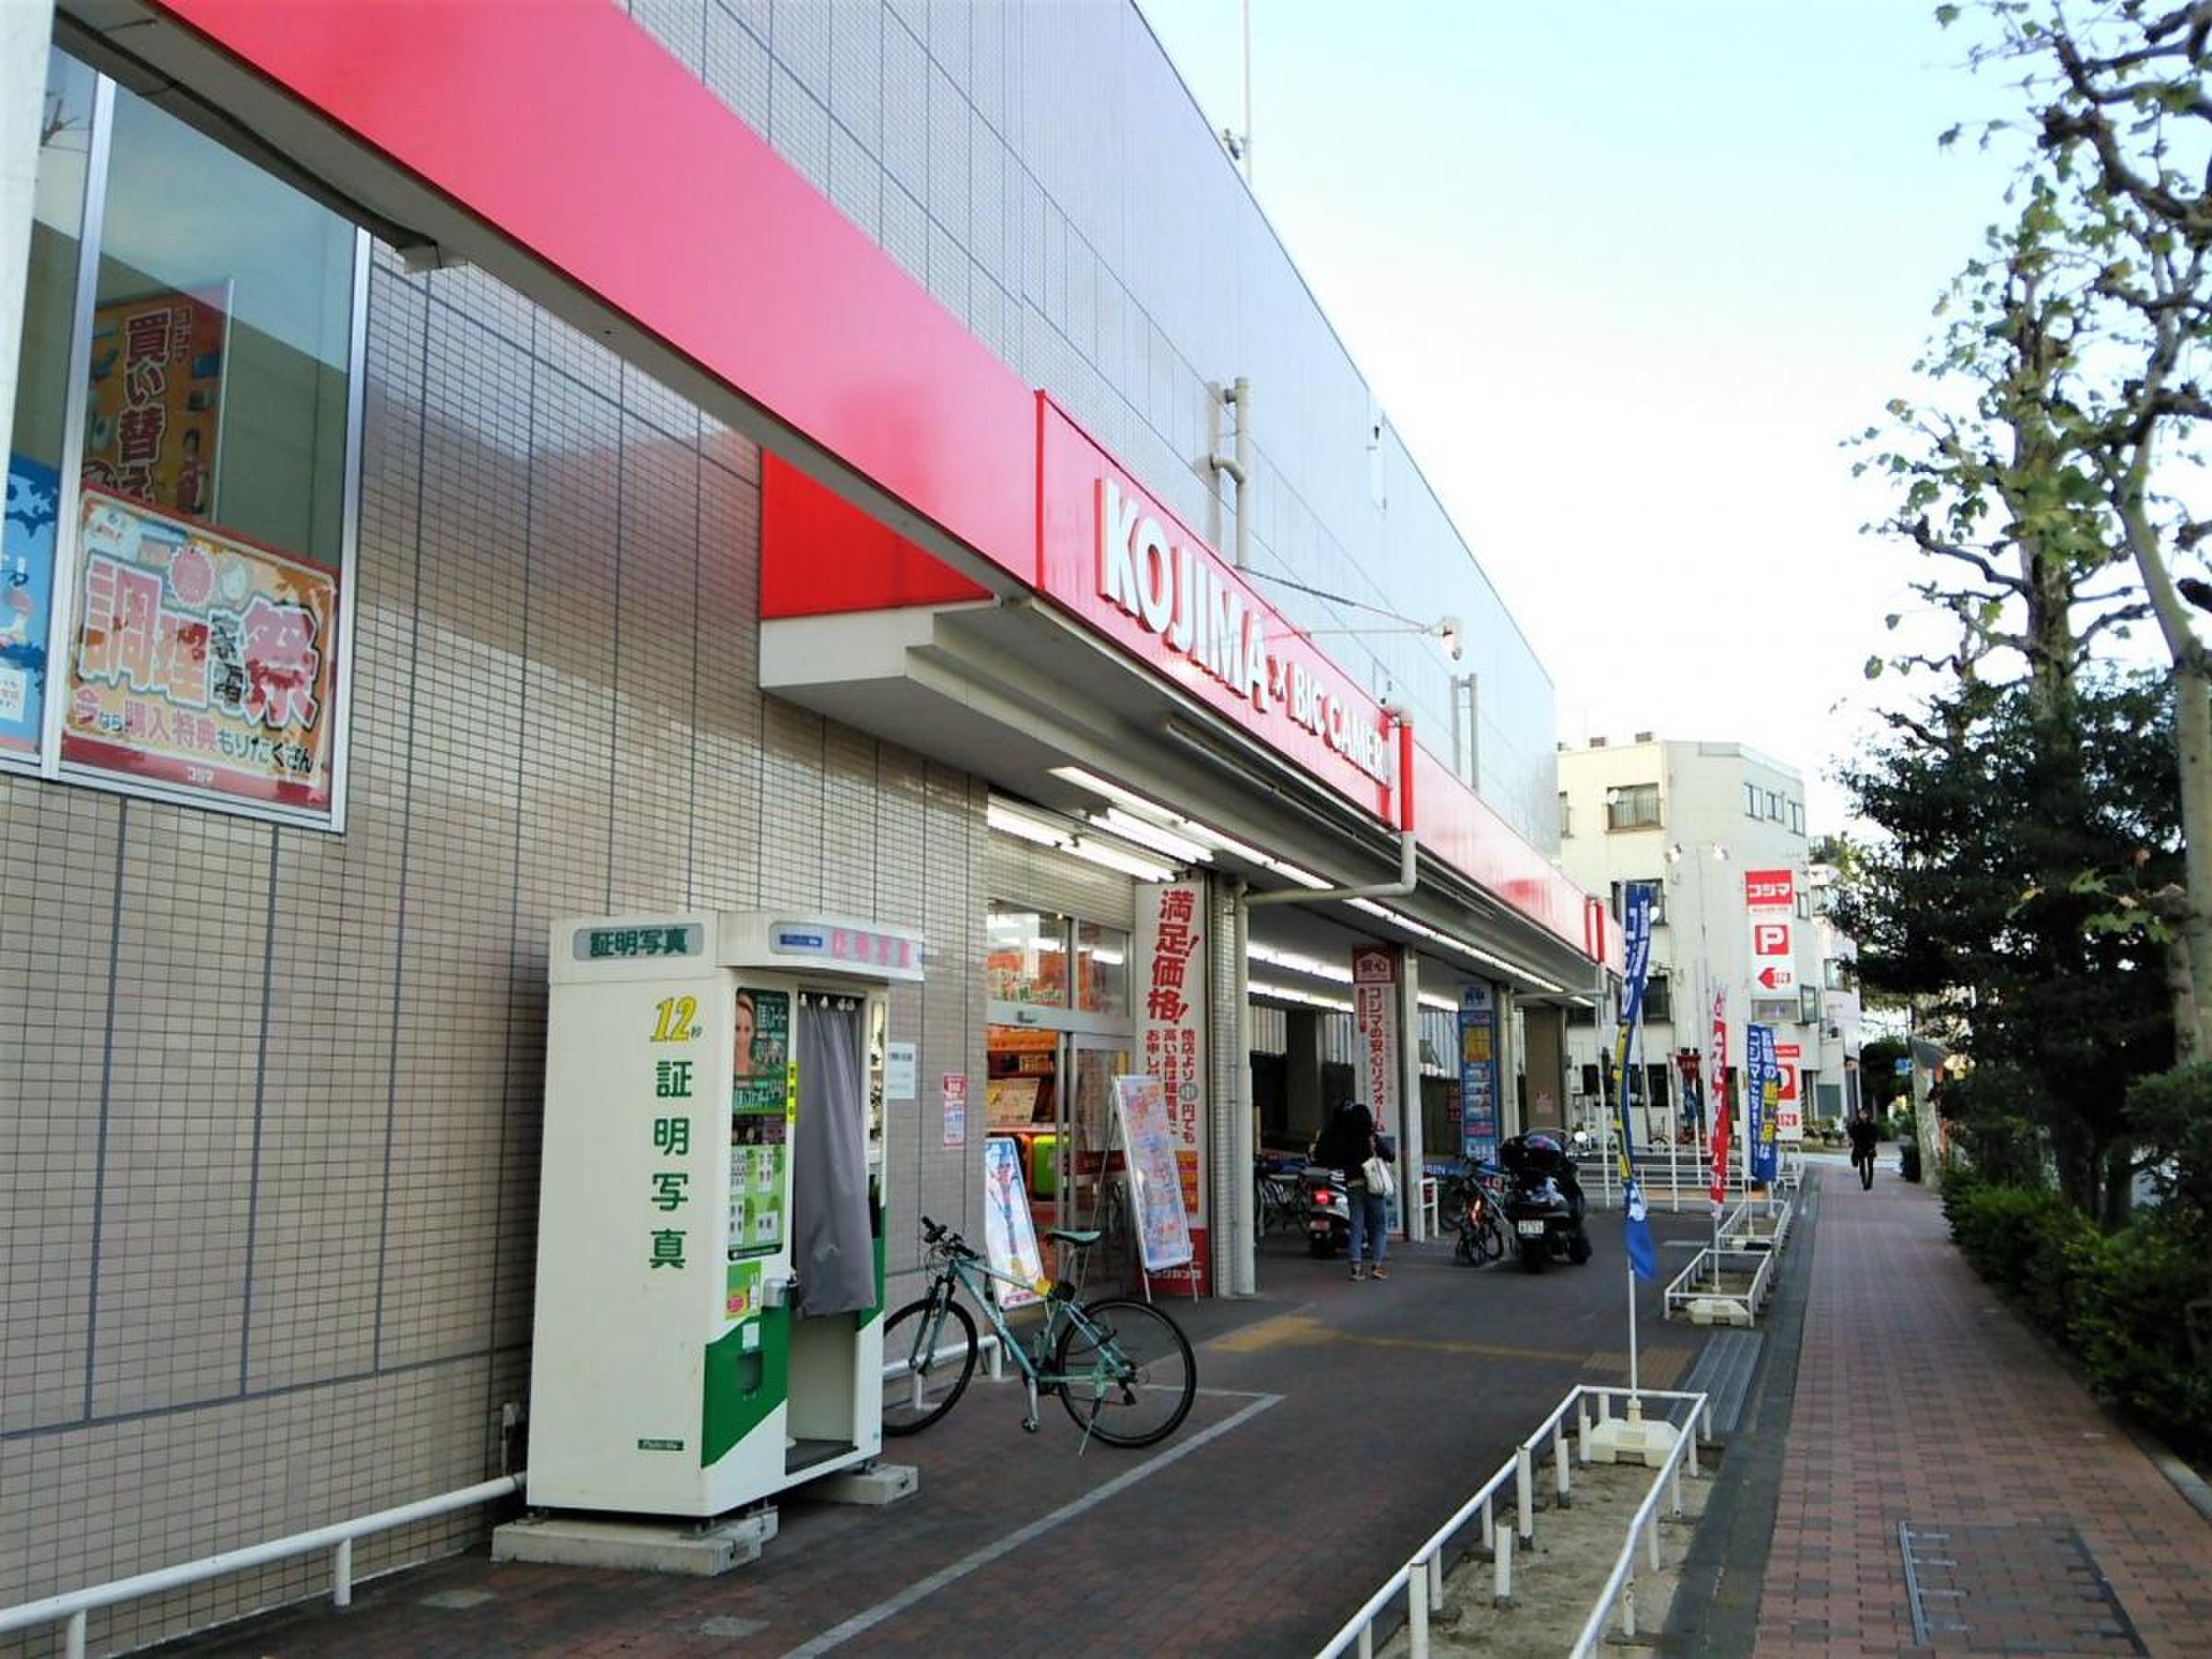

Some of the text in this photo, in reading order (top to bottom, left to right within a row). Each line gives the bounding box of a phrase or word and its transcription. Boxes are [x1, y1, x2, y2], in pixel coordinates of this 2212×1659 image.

[1095, 477, 1268, 714] KOJIMA
[1287, 669, 1325, 737] BIC
[1324, 694, 1392, 793] CAMER
[1748, 885, 1791, 898] コジマ
[588, 928, 688, 958] 証明写真
[1760, 926, 1784, 953] P
[649, 1061, 693, 1269] 証明写真
